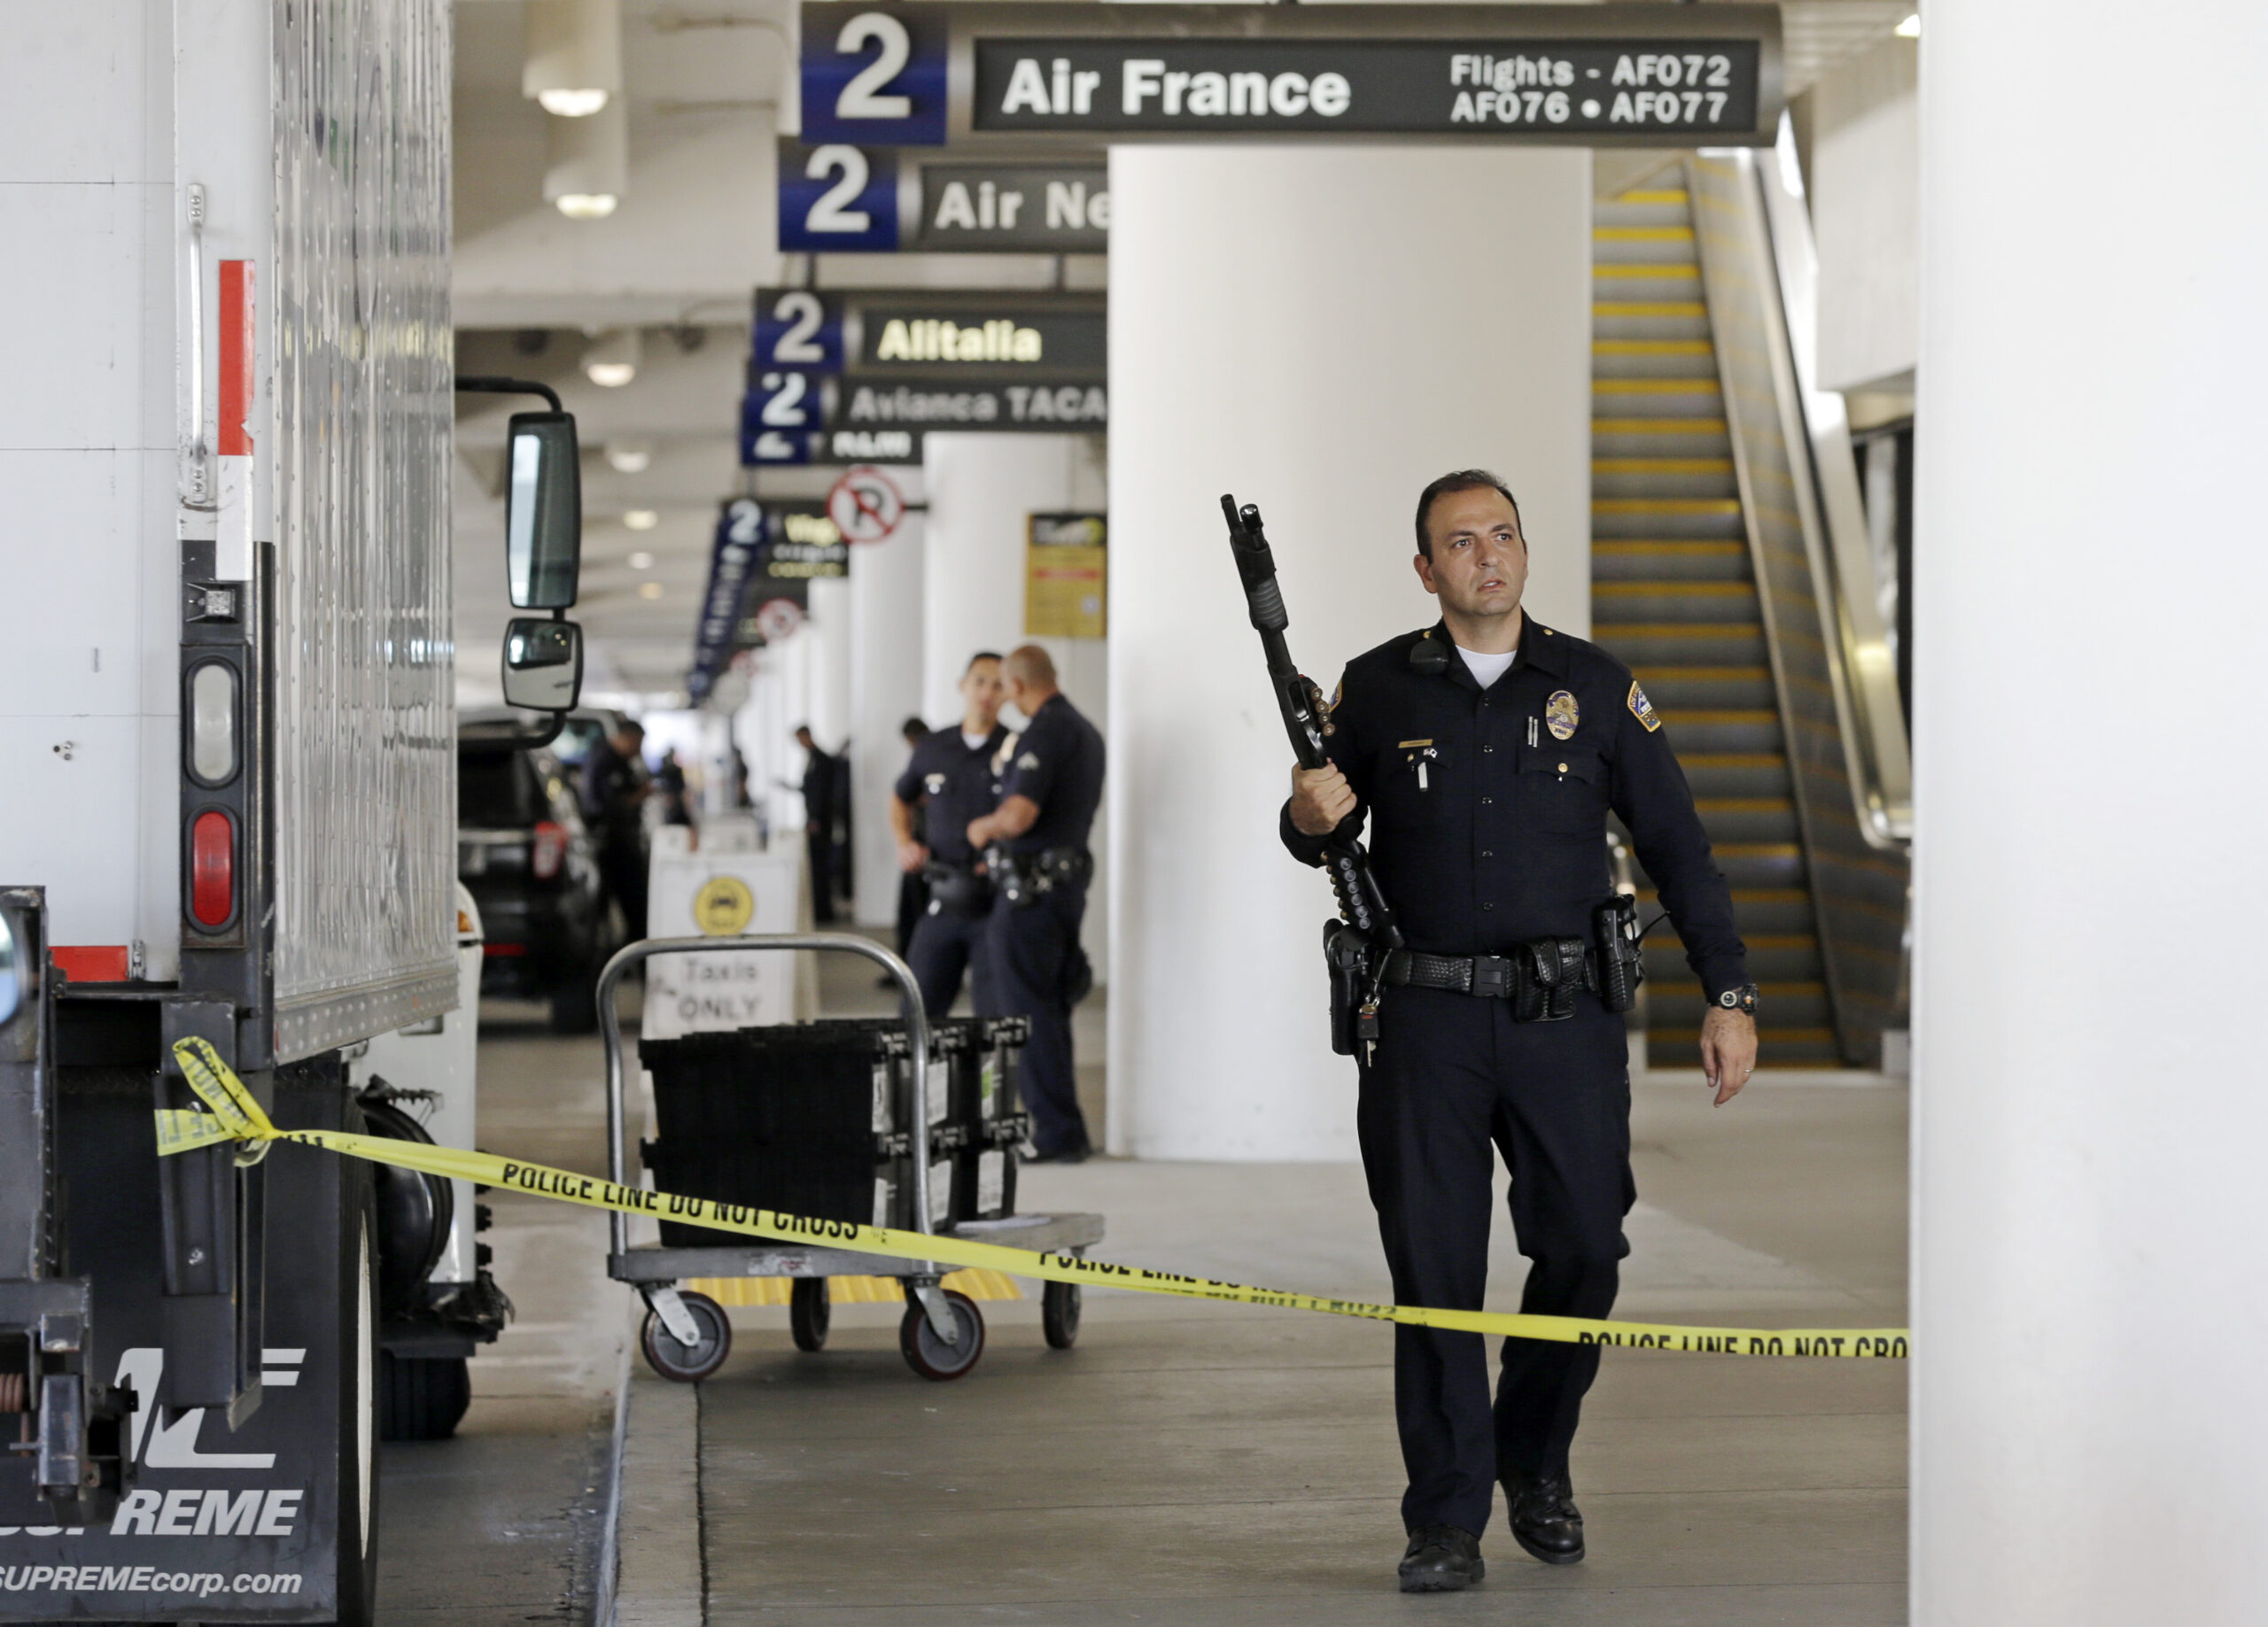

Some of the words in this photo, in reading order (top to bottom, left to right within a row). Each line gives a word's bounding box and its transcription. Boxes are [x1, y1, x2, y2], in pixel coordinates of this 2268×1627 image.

[835, 12, 911, 119] 2
[1001, 58, 1101, 114] Air
[1122, 58, 1351, 117] France
[1450, 54, 1575, 92] Flights
[1611, 54, 1731, 87] AF072
[1450, 90, 1571, 123] AF076
[1609, 90, 1728, 123] AF077
[805, 144, 870, 233] 2
[934, 181, 1023, 229] Air
[773, 292, 824, 362] 2
[877, 319, 1043, 361] Alitalia
[761, 373, 806, 426] 2
[849, 386, 998, 422] Avianca
[1005, 386, 1107, 422] TACA
[683, 957, 758, 983] Taxis
[678, 996, 761, 1020] ONLY
[502, 1162, 594, 1200] POLICE
[602, 1183, 659, 1211] LINE
[669, 1194, 703, 1218] DO
[713, 1201, 760, 1228] NOT
